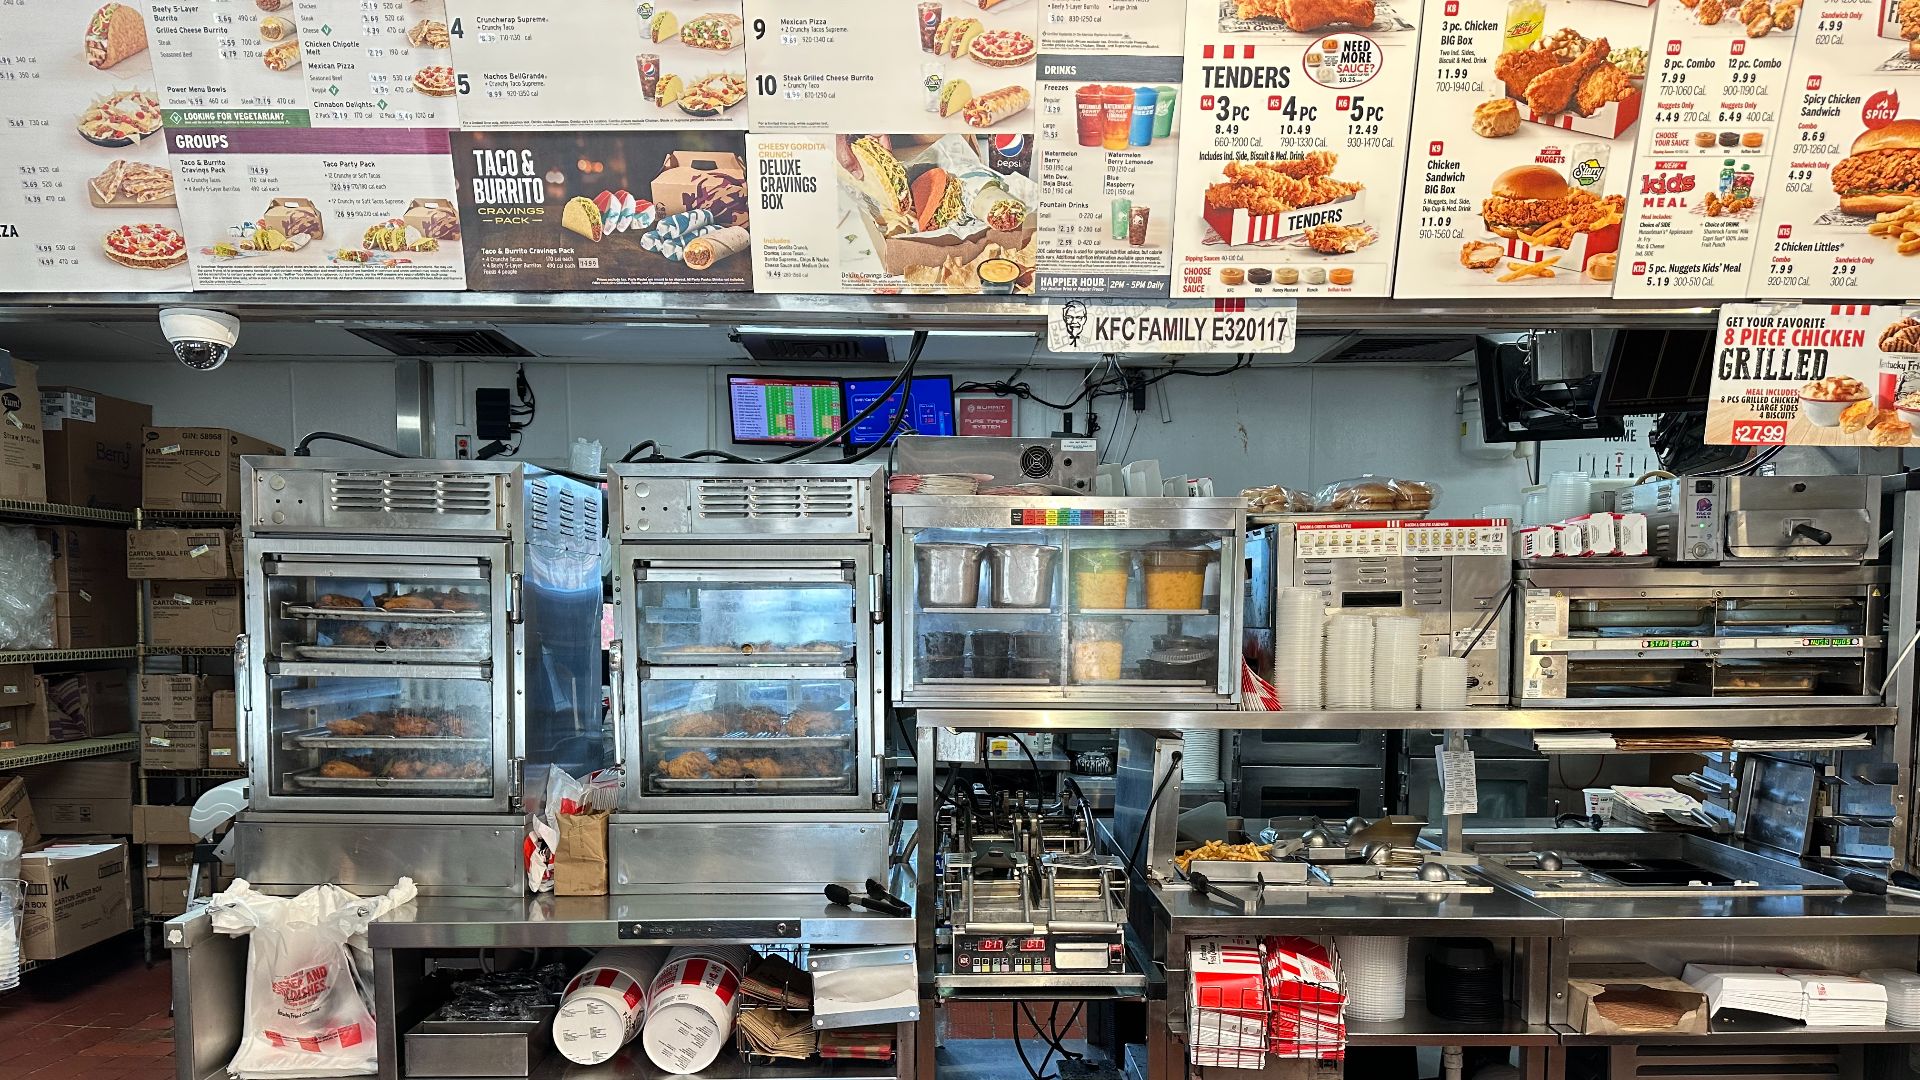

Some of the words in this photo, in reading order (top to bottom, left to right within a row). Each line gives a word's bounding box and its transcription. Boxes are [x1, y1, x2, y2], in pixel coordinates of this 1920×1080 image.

[1446, 4, 1457, 12] K8
[450, 17, 464, 39] 4
[753, 18, 766, 40] 9
[1442, 22, 1448, 31] 3
[1449, 23, 1462, 33] pc.
[1464, 21, 1498, 31] Chicken
[1818, 21, 1842, 31] 4.99
[1441, 36, 1456, 45] BIG
[1457, 36, 1473, 45] Box
[1344, 40, 1371, 52] NEED
[1668, 44, 1681, 52] K10
[1732, 44, 1744, 52] K11
[1340, 52, 1372, 63] MORE
[1336, 64, 1375, 74] SAUCE?
[1664, 59, 1670, 68] 8
[1670, 61, 1684, 70] pc.
[1686, 58, 1716, 68] Combo
[1728, 59, 1737, 68] 12
[1738, 61, 1752, 70] pc.
[1753, 58, 1782, 68] Combo
[1044, 66, 1077, 75] DRINKS
[1437, 69, 1468, 79] 11.99
[1202, 66, 1291, 89] TENDERS
[1661, 73, 1686, 83] 7.99
[1732, 73, 1756, 83] 9.99
[457, 74, 471, 95] 5
[756, 74, 777, 96] 10
[1808, 79, 1820, 88] K14
[1202, 99, 1212, 108] K4
[1270, 99, 1280, 108] K5
[1338, 99, 1348, 108] K6
[1803, 95, 1826, 106] Spicy
[1828, 94, 1861, 104] Chicken
[184, 112, 214, 121] LOOKING
[216, 112, 231, 121] FOR
[232, 112, 285, 121] VEGETARIAN?
[1655, 112, 1680, 122] 4.49
[1718, 112, 1742, 122] 6.49
[1800, 107, 1841, 117] Sandwich
[1865, 109, 1896, 120] SPICY
[1215, 124, 1239, 134] 8.49
[1280, 124, 1311, 134] 10.49
[1348, 124, 1378, 134] 12.49
[176, 134, 228, 149] GROUPS
[1802, 132, 1825, 142] 8.69
[1431, 145, 1442, 154] K9
[473, 150, 518, 176] TACO
[522, 150, 536, 176] &
[997, 160, 1021, 168] pepsi
[1427, 160, 1460, 170] Chicken
[1535, 156, 1566, 164] NUGGETS
[760, 160, 802, 176] DELUXE
[1573, 162, 1604, 181] Starry
[1426, 172, 1465, 182] Sandwich
[1788, 171, 1812, 180] 4.99
[760, 176, 817, 192] CRAVINGS
[1640, 173, 1696, 195] kids
[474, 178, 544, 204] BURRITO
[1424, 185, 1438, 194] BIG
[1440, 185, 1455, 194] Box
[761, 194, 784, 210] BOX
[1643, 198, 1688, 208] MEAL
[477, 208, 545, 216] CRAVINGS
[495, 216, 530, 224] PACK
[1288, 208, 1343, 230] TENDERS
[1421, 217, 1452, 226] 11.09
[1778, 227, 1791, 236] K15
[1774, 243, 1780, 252] 2
[1782, 242, 1812, 252] Chicken
[1184, 268, 1212, 276] CHOOSE
[1633, 264, 1646, 272] K12
[1648, 264, 1654, 272] 5
[1655, 266, 1667, 274] pc.
[1668, 264, 1701, 274] Nuggets
[1724, 264, 1742, 272] Meal
[1770, 265, 1793, 274] 7.99
[1832, 265, 1856, 274] 2.99
[1040, 277, 1079, 287] HAPPIER
[1110, 281, 1125, 289] 2PM
[1131, 281, 1146, 289] 5PM
[1147, 281, 1164, 290] Daily
[1647, 277, 1670, 286] 5.19
[1182, 285, 1205, 293] SAUCE
[1726, 317, 1746, 328] GET
[1747, 317, 1774, 328] YOUR
[1776, 318, 1826, 328] FAVORITE
[1096, 318, 1136, 341] KFC
[1138, 318, 1208, 341] FAMILY
[1212, 318, 1288, 341] E320117
[1724, 328, 1734, 346] 8
[1740, 329, 1788, 346] PIECE
[1792, 330, 1865, 347] CHICKEN
[1718, 348, 1828, 380] GRILLED
[3, 396, 20, 408] Yum!
[1735, 426, 1784, 442] $27.99
[96, 442, 130, 468] Berry
[177, 448, 221, 457] INTERFOLD
[53, 875, 70, 892] YK
